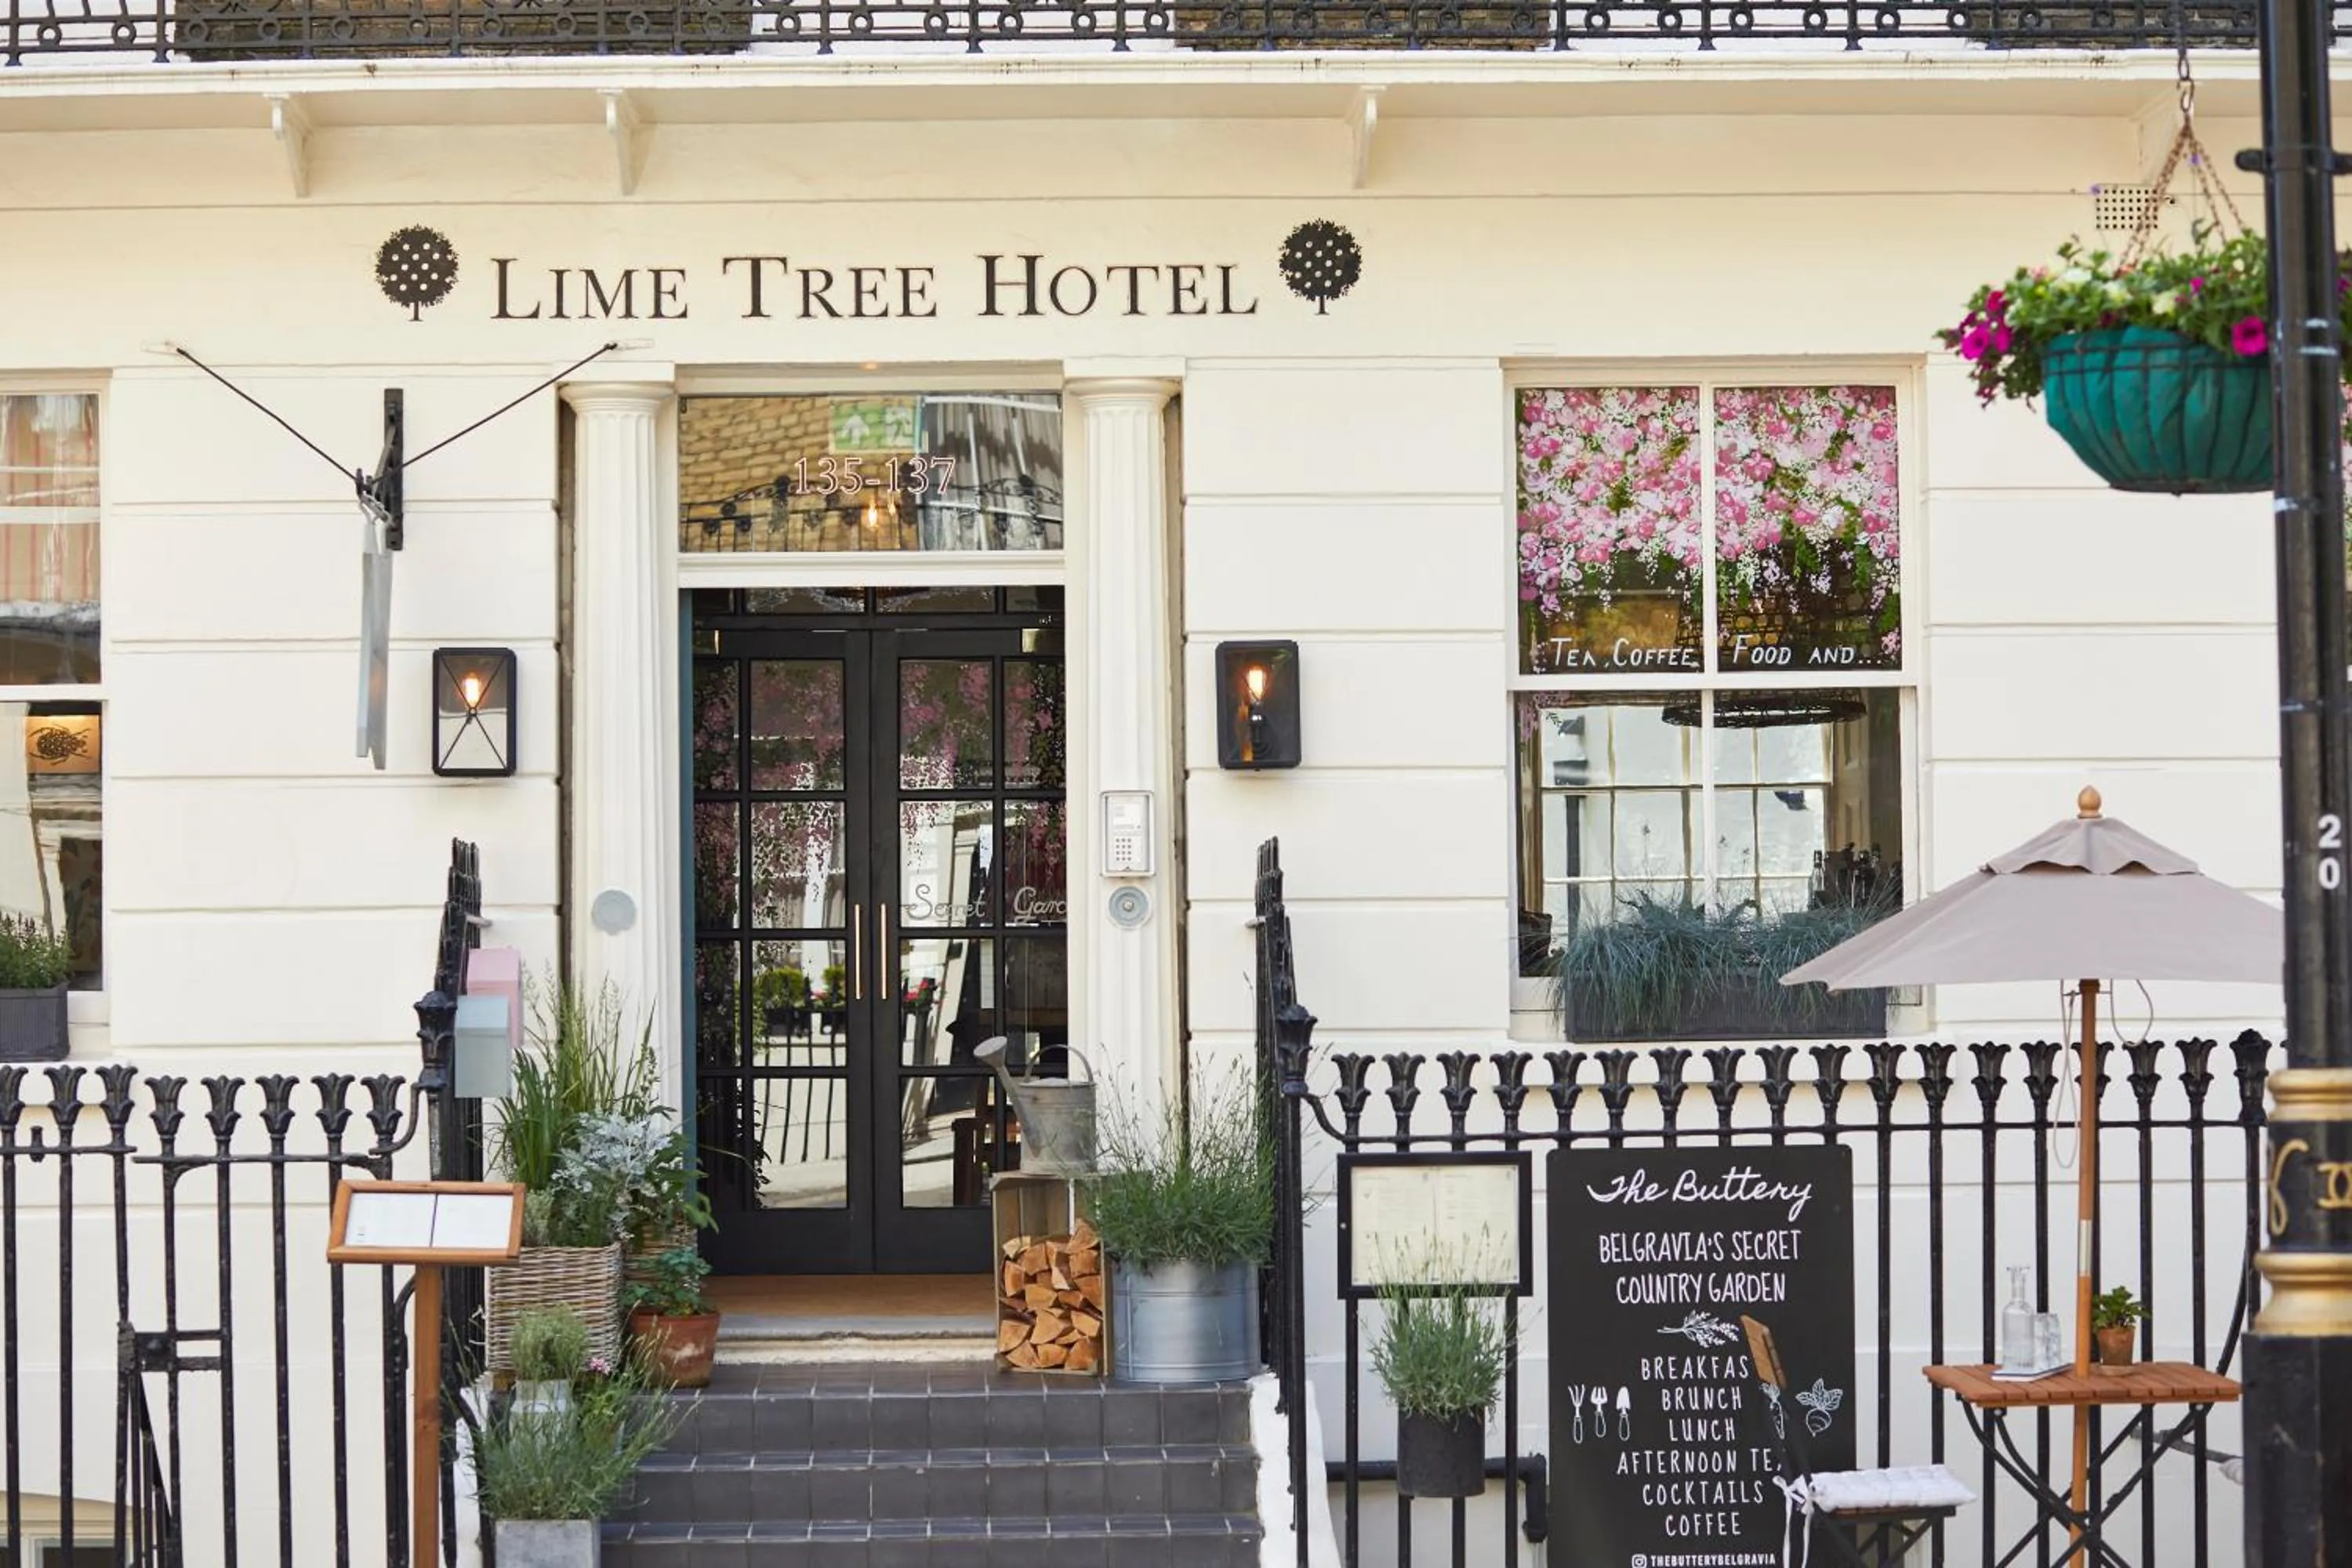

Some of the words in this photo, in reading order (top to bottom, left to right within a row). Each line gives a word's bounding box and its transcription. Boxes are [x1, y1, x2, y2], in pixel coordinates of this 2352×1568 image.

[492, 258, 688, 319] LIME
[722, 256, 937, 318] TREE
[978, 255, 1258, 316] HOTEL
[794, 457, 956, 495] 135-137
[1733, 633, 1792, 665] FOOD
[902, 884, 985, 920] Secret
[1587, 1169, 1668, 1204] The
[1672, 1167, 1812, 1222] Buttery
[1599, 1232, 1724, 1263] BELGRAVIA'S
[1732, 1230, 1802, 1261] SECRET
[1617, 1273, 1703, 1304] COUNTRY
[1709, 1272, 1785, 1302] GARDEN
[1642, 1356, 1750, 1381] BREAKFAS
[1661, 1386, 1742, 1411] BRUNCH
[1669, 1417, 1735, 1442] LUNCH
[1617, 1450, 1737, 1475] AFTERNOON
[1642, 1480, 1763, 1506] COCKTAILS
[1665, 1512, 1741, 1537] COFFEE
[1650, 1553, 1776, 1567] THEBUTTERYBELGRAVIA
